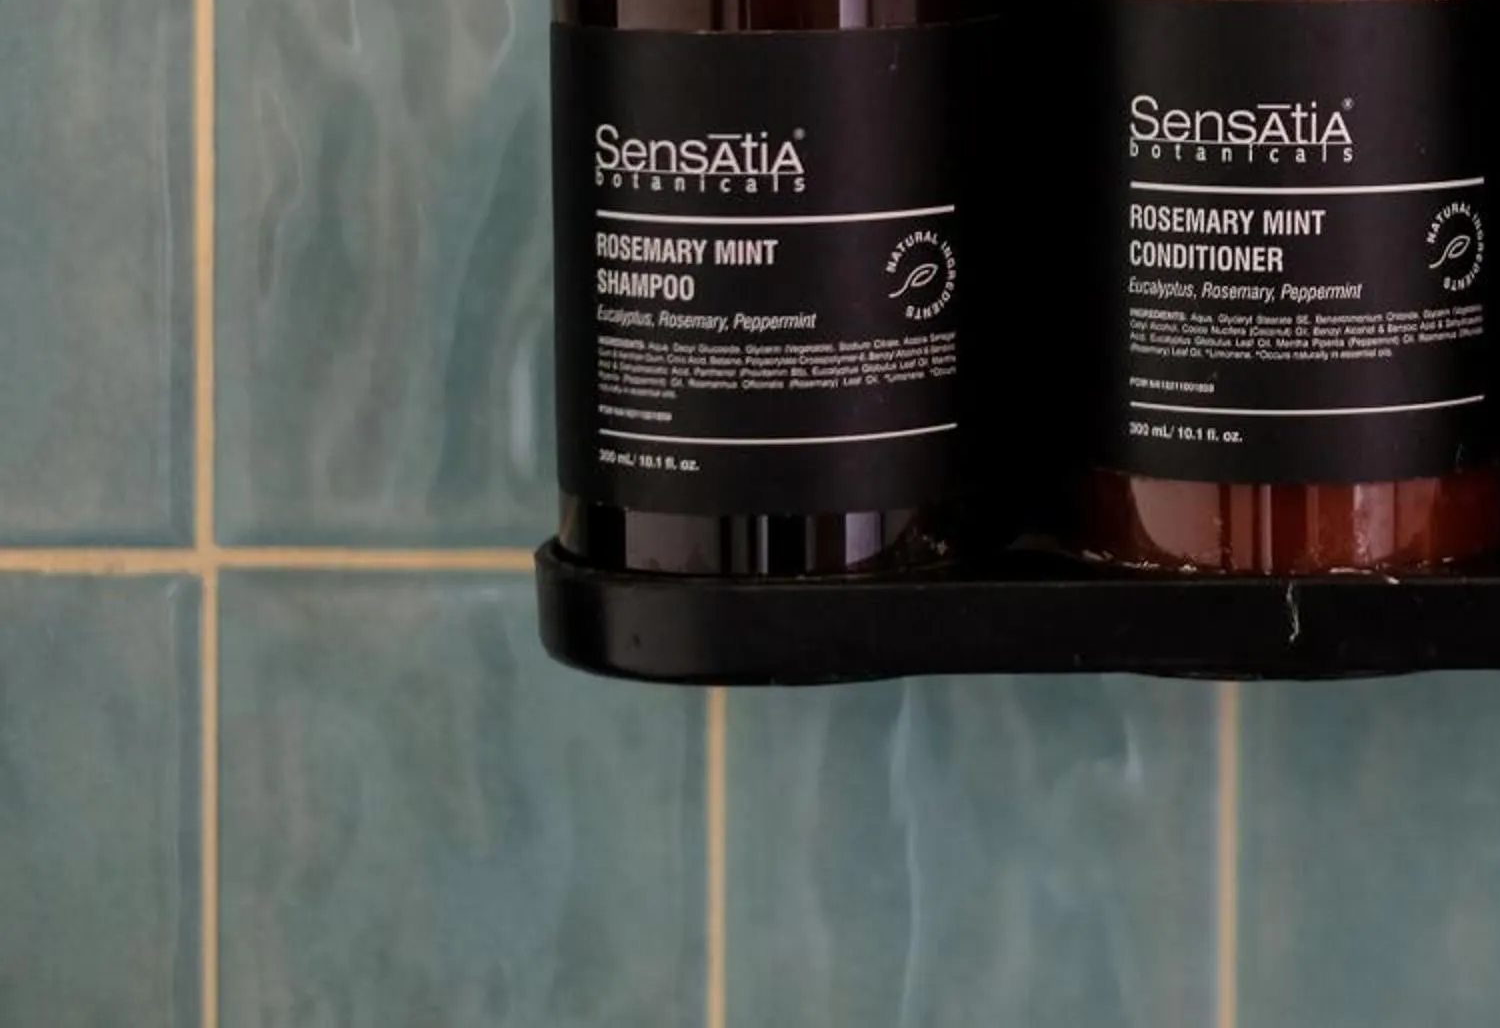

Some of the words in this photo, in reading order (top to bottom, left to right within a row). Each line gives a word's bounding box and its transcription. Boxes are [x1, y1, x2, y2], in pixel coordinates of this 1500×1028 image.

[1129, 137, 1354, 163] botanicals
[595, 167, 806, 193] botanicals
[1129, 203, 1254, 236] ROSEMARY
[1263, 210, 1327, 236] MINT
[1426, 200, 1471, 245] NATURAL
[596, 233, 705, 264] ROSEMARY
[714, 239, 779, 265] MINT
[884, 230, 940, 274] NATURAL
[1129, 239, 1284, 273] CONDITIONER
[596, 268, 695, 301] SHAMPOO
[1128, 275, 1197, 300] Eucalyptus,
[1201, 281, 1276, 305] Rosemary,
[1280, 282, 1364, 304] Peppermint
[658, 310, 730, 333] Rosemary,
[732, 312, 817, 333] Peppermint
[1128, 422, 1150, 437] 300
[1177, 427, 1203, 442] 10.1
[1223, 431, 1244, 443] oz.
[638, 454, 662, 470] 10.1
[680, 458, 701, 472] oz.
